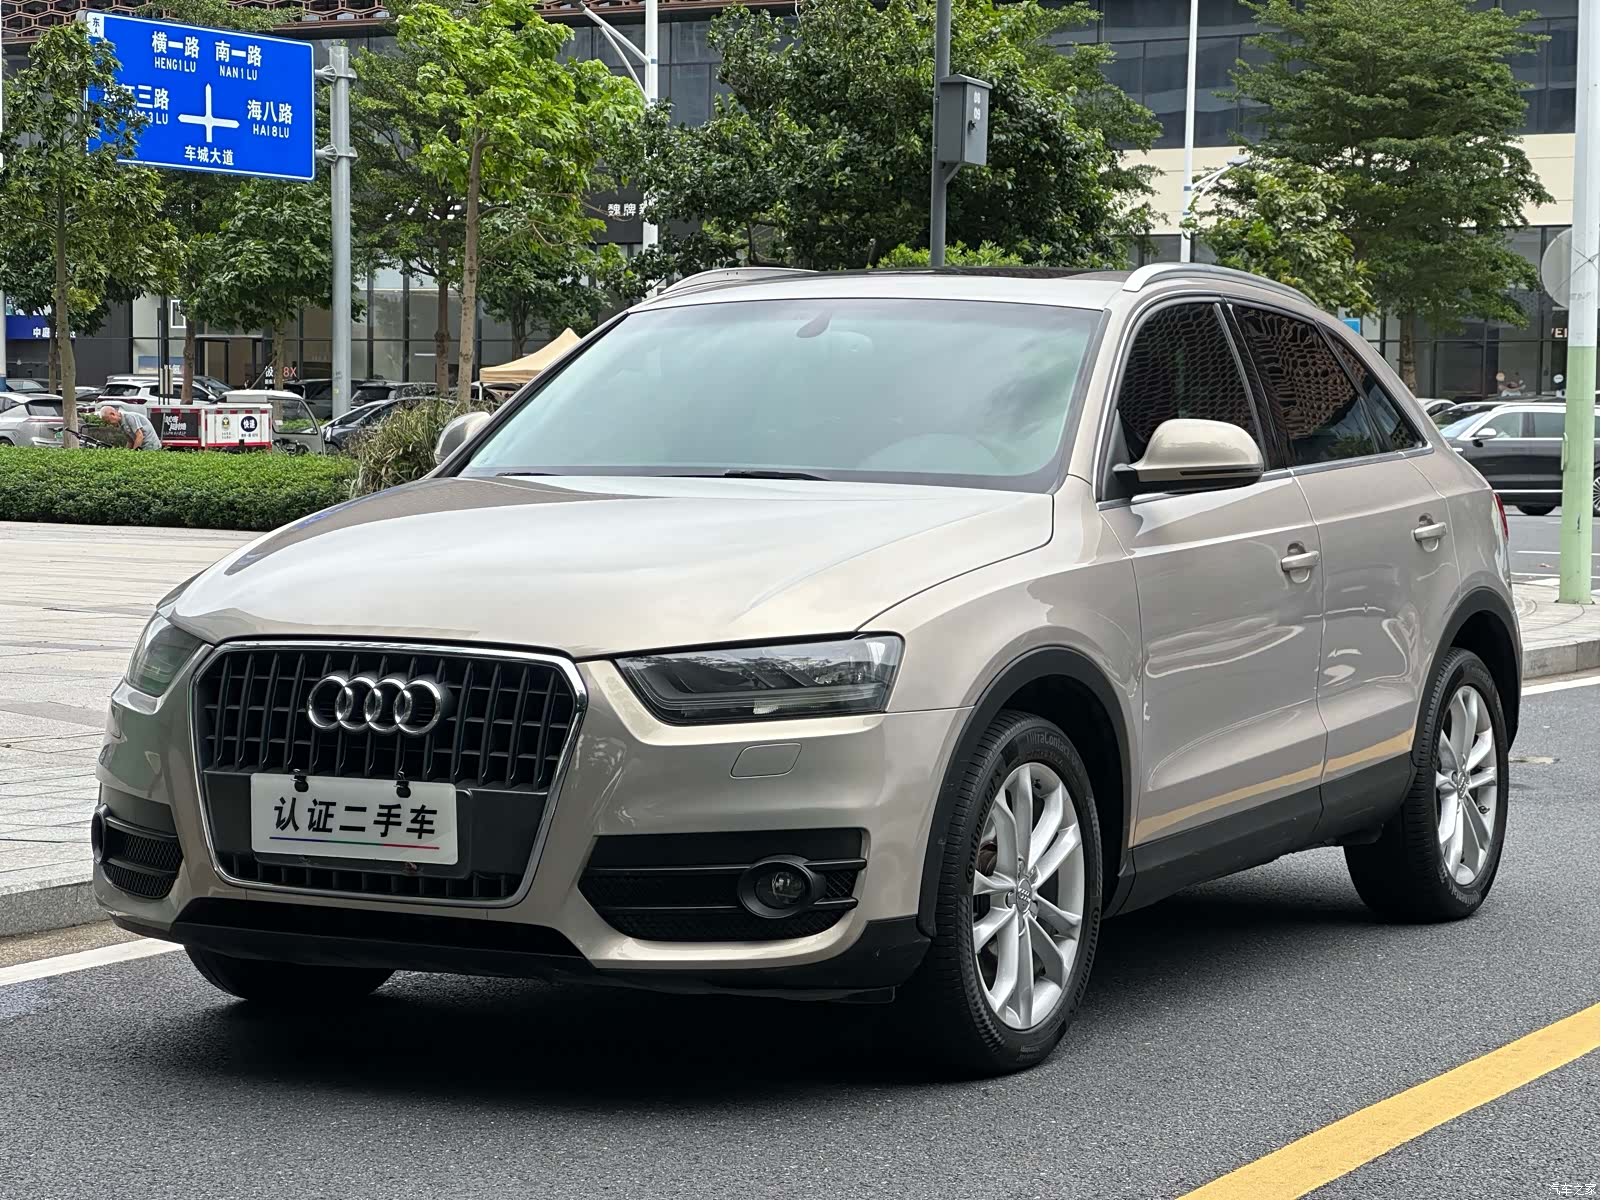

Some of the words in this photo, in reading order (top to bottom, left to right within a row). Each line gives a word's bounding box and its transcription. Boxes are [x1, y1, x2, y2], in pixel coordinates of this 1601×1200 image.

[152, 31, 200, 59] 横一路
[215, 40, 262, 67] 南一路
[247, 99, 293, 125] 海八路
[184, 144, 234, 166] 车城大道
[242, 418, 256, 429] 快递
[273, 796, 438, 840] 认证二手车
